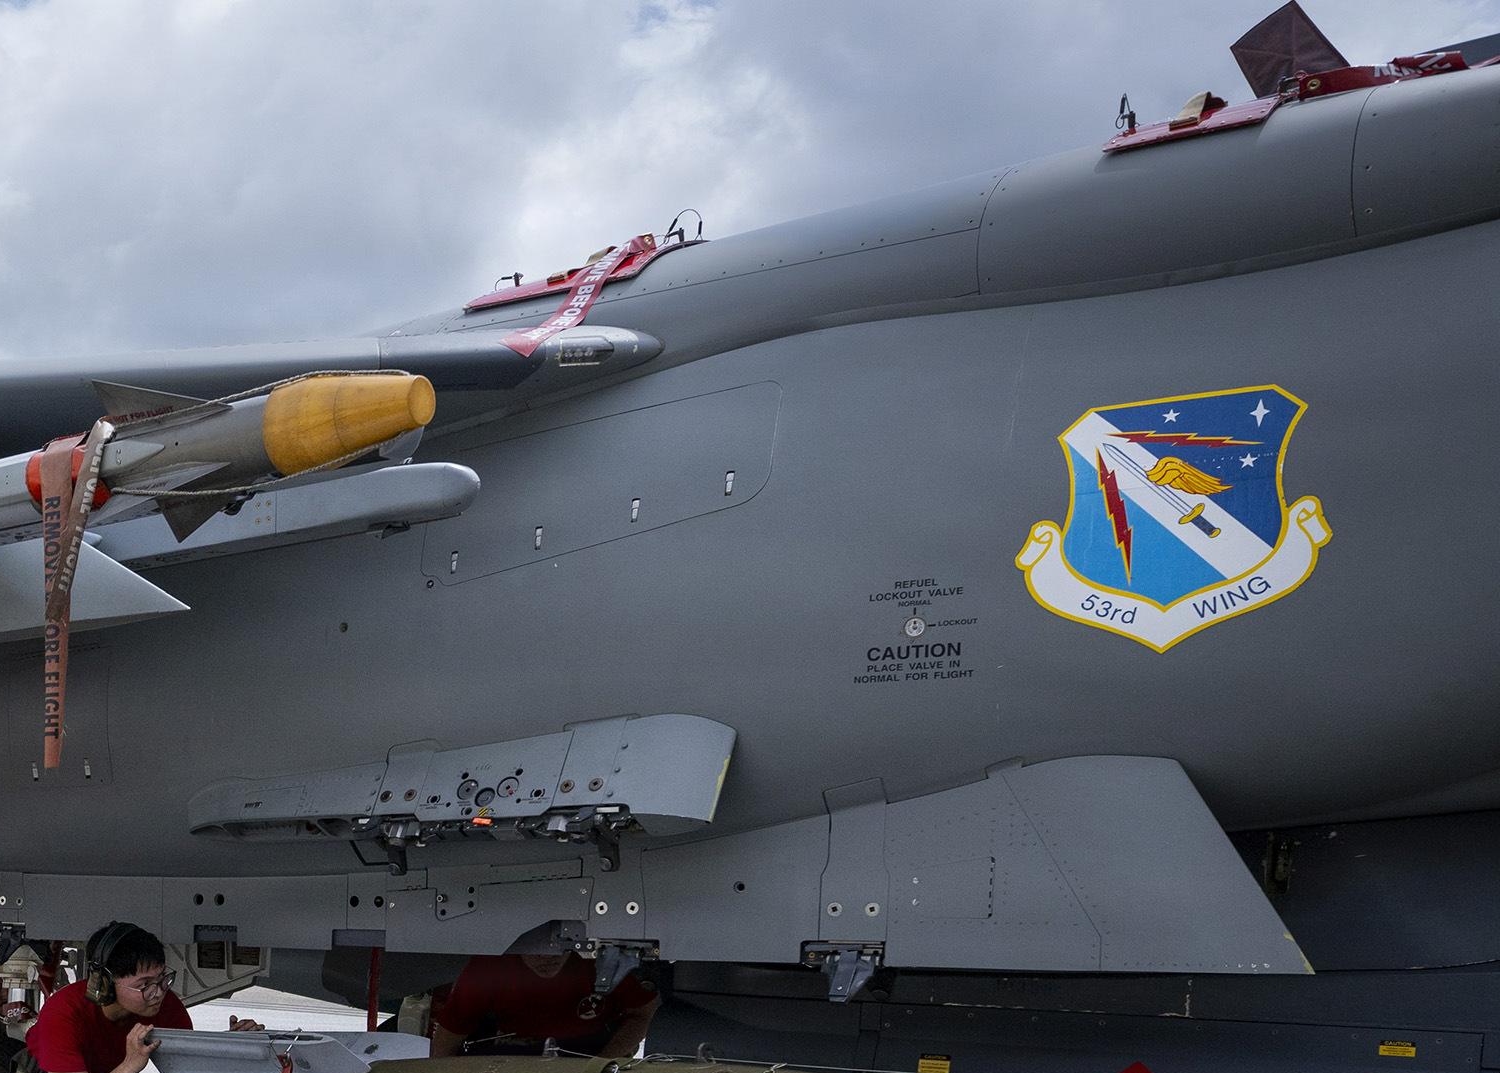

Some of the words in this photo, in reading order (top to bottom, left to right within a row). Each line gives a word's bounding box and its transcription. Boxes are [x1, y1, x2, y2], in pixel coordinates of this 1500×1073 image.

[552, 283, 597, 327] BEFORE
[147, 404, 175, 417] FLIGHT
[894, 578, 939, 590] REFUEL
[868, 589, 923, 602] LOCKOUT
[928, 586, 964, 598] VALVE
[1080, 593, 1138, 625] 53rd
[1192, 575, 1272, 619] WING
[898, 599, 933, 608] NORMAL
[937, 617, 978, 627] LOCKOUT
[866, 642, 961, 661] CAUTION
[866, 662, 904, 673] PLACE
[908, 659, 944, 670] VALVE
[948, 659, 960, 668] IN
[853, 674, 900, 684] NORMAL
[905, 671, 929, 681] FOR
[933, 669, 975, 680] FLIGHT
